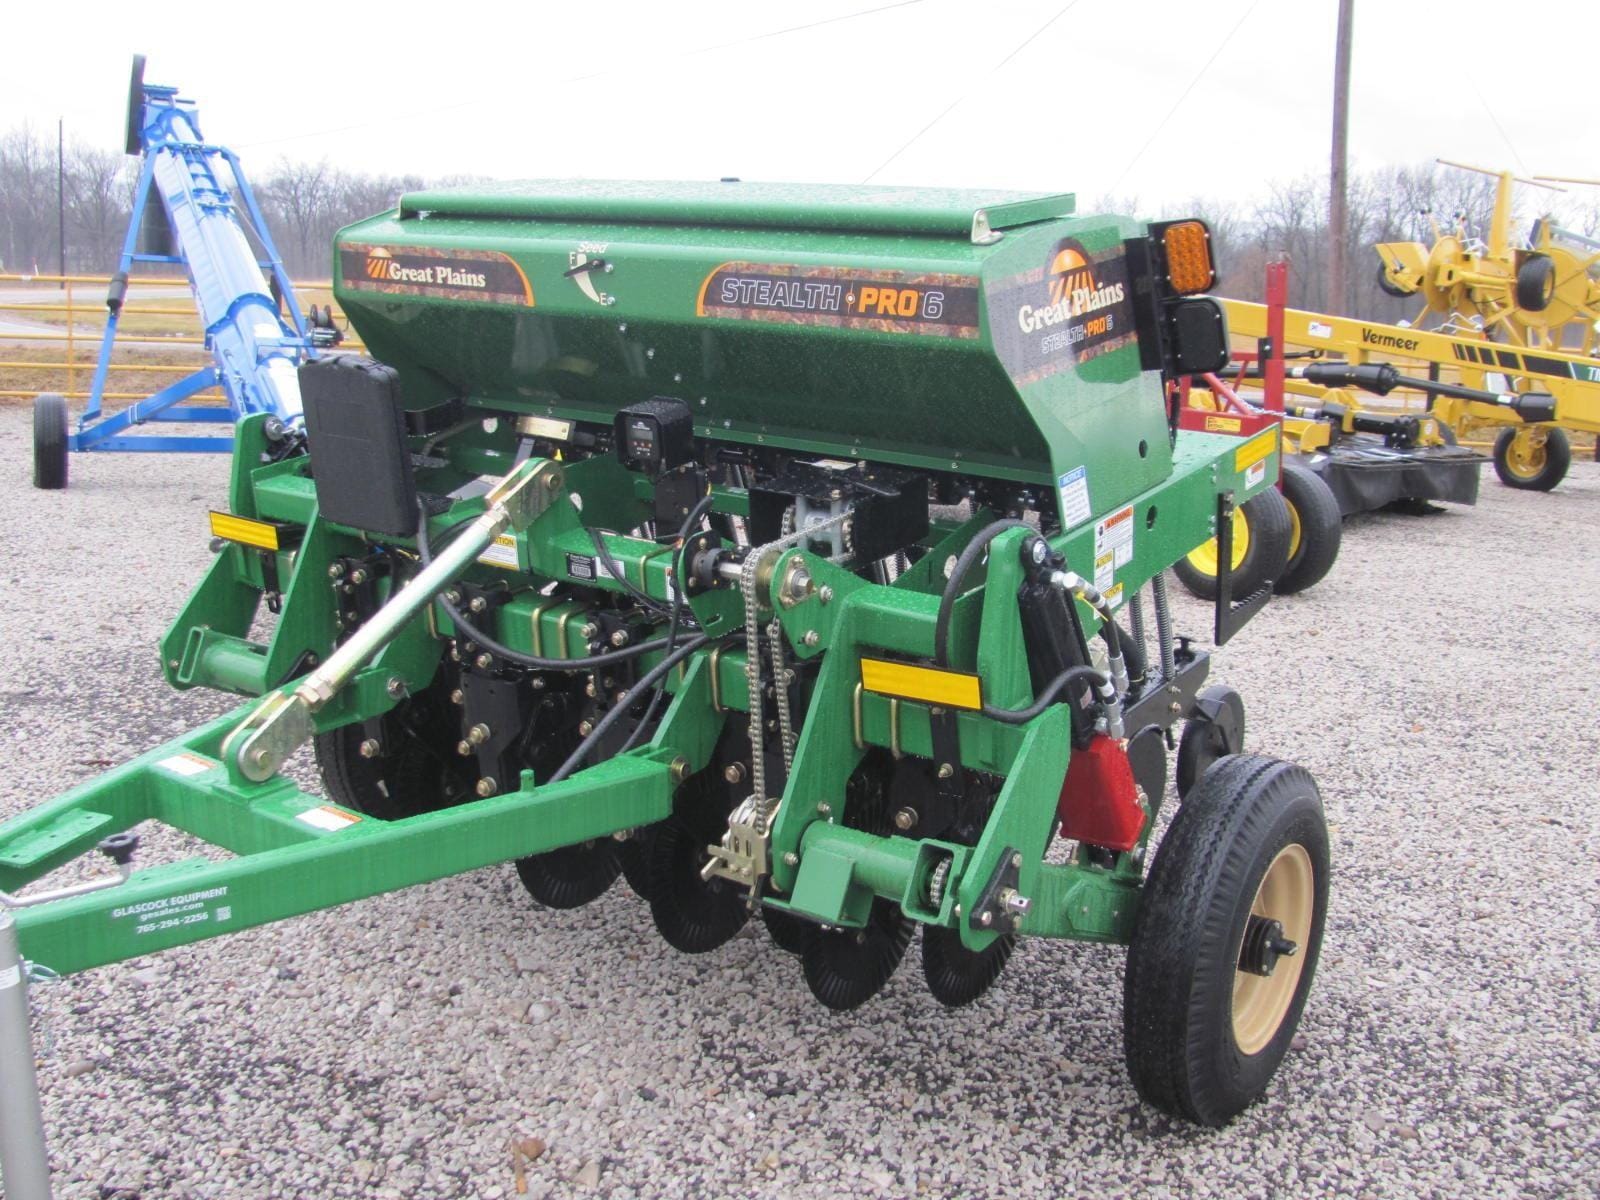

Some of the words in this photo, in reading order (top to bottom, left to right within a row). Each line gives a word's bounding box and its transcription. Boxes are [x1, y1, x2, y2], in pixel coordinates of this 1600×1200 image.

[389, 263, 433, 283] Great
[436, 266, 486, 288] Plains
[721, 278, 842, 310] STEALTH
[858, 286, 918, 317] PRO
[921, 291, 945, 319] 6
[1018, 296, 1072, 333] Great
[1072, 282, 1125, 316] Plains
[1041, 324, 1084, 354] STEALTH
[1087, 317, 1106, 338] PRO
[1362, 328, 1420, 351] Vermeer
[112, 898, 168, 918] GLASCOCK
[170, 886, 228, 907] EQUIPMENT
[140, 902, 204, 921] gesales.com
[136, 911, 209, 934] 765-294-2256
